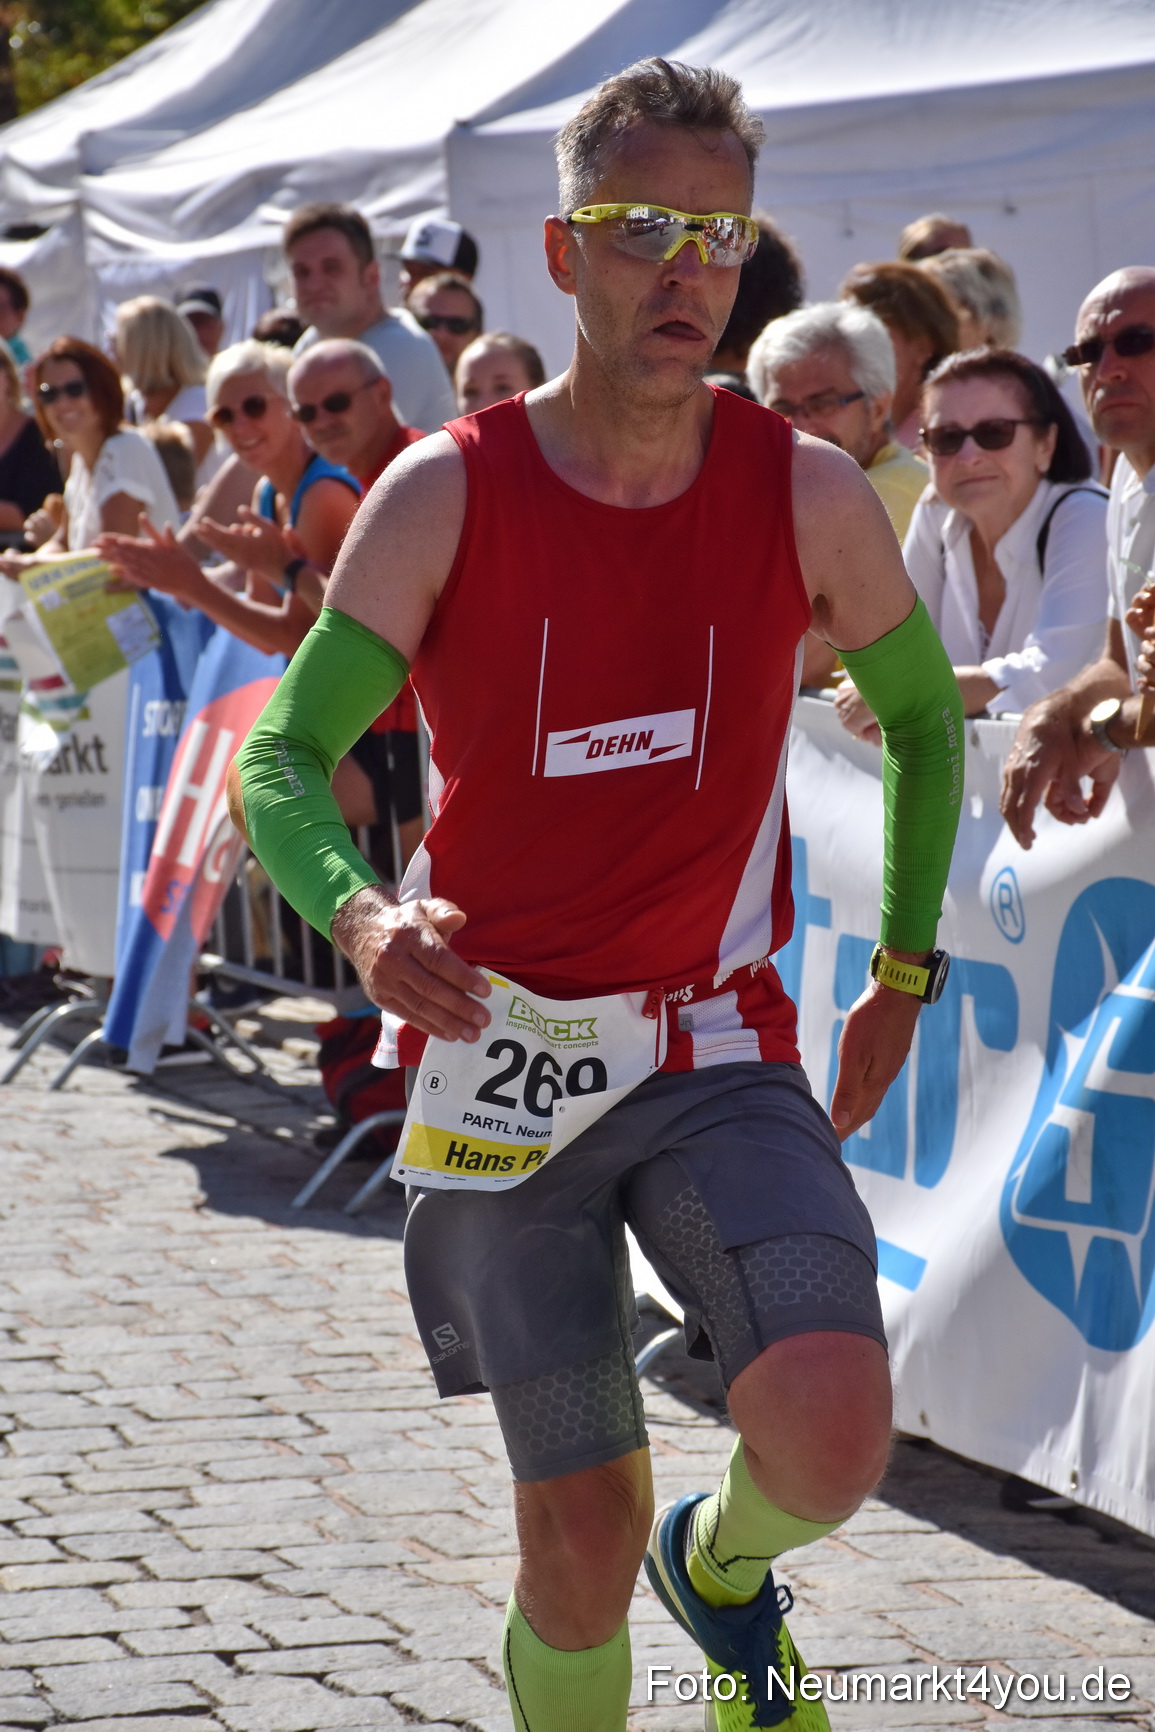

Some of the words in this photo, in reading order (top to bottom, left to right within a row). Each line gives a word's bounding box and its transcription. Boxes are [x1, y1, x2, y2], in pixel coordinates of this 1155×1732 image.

[585, 730, 654, 759] DEHN
[508, 995, 598, 1041] BOCK
[506, 1019, 537, 1033] inspired
[563, 1040, 599, 1049] concepts
[462, 1112, 512, 1135] PARTL
[445, 1141, 516, 1172] Hans
